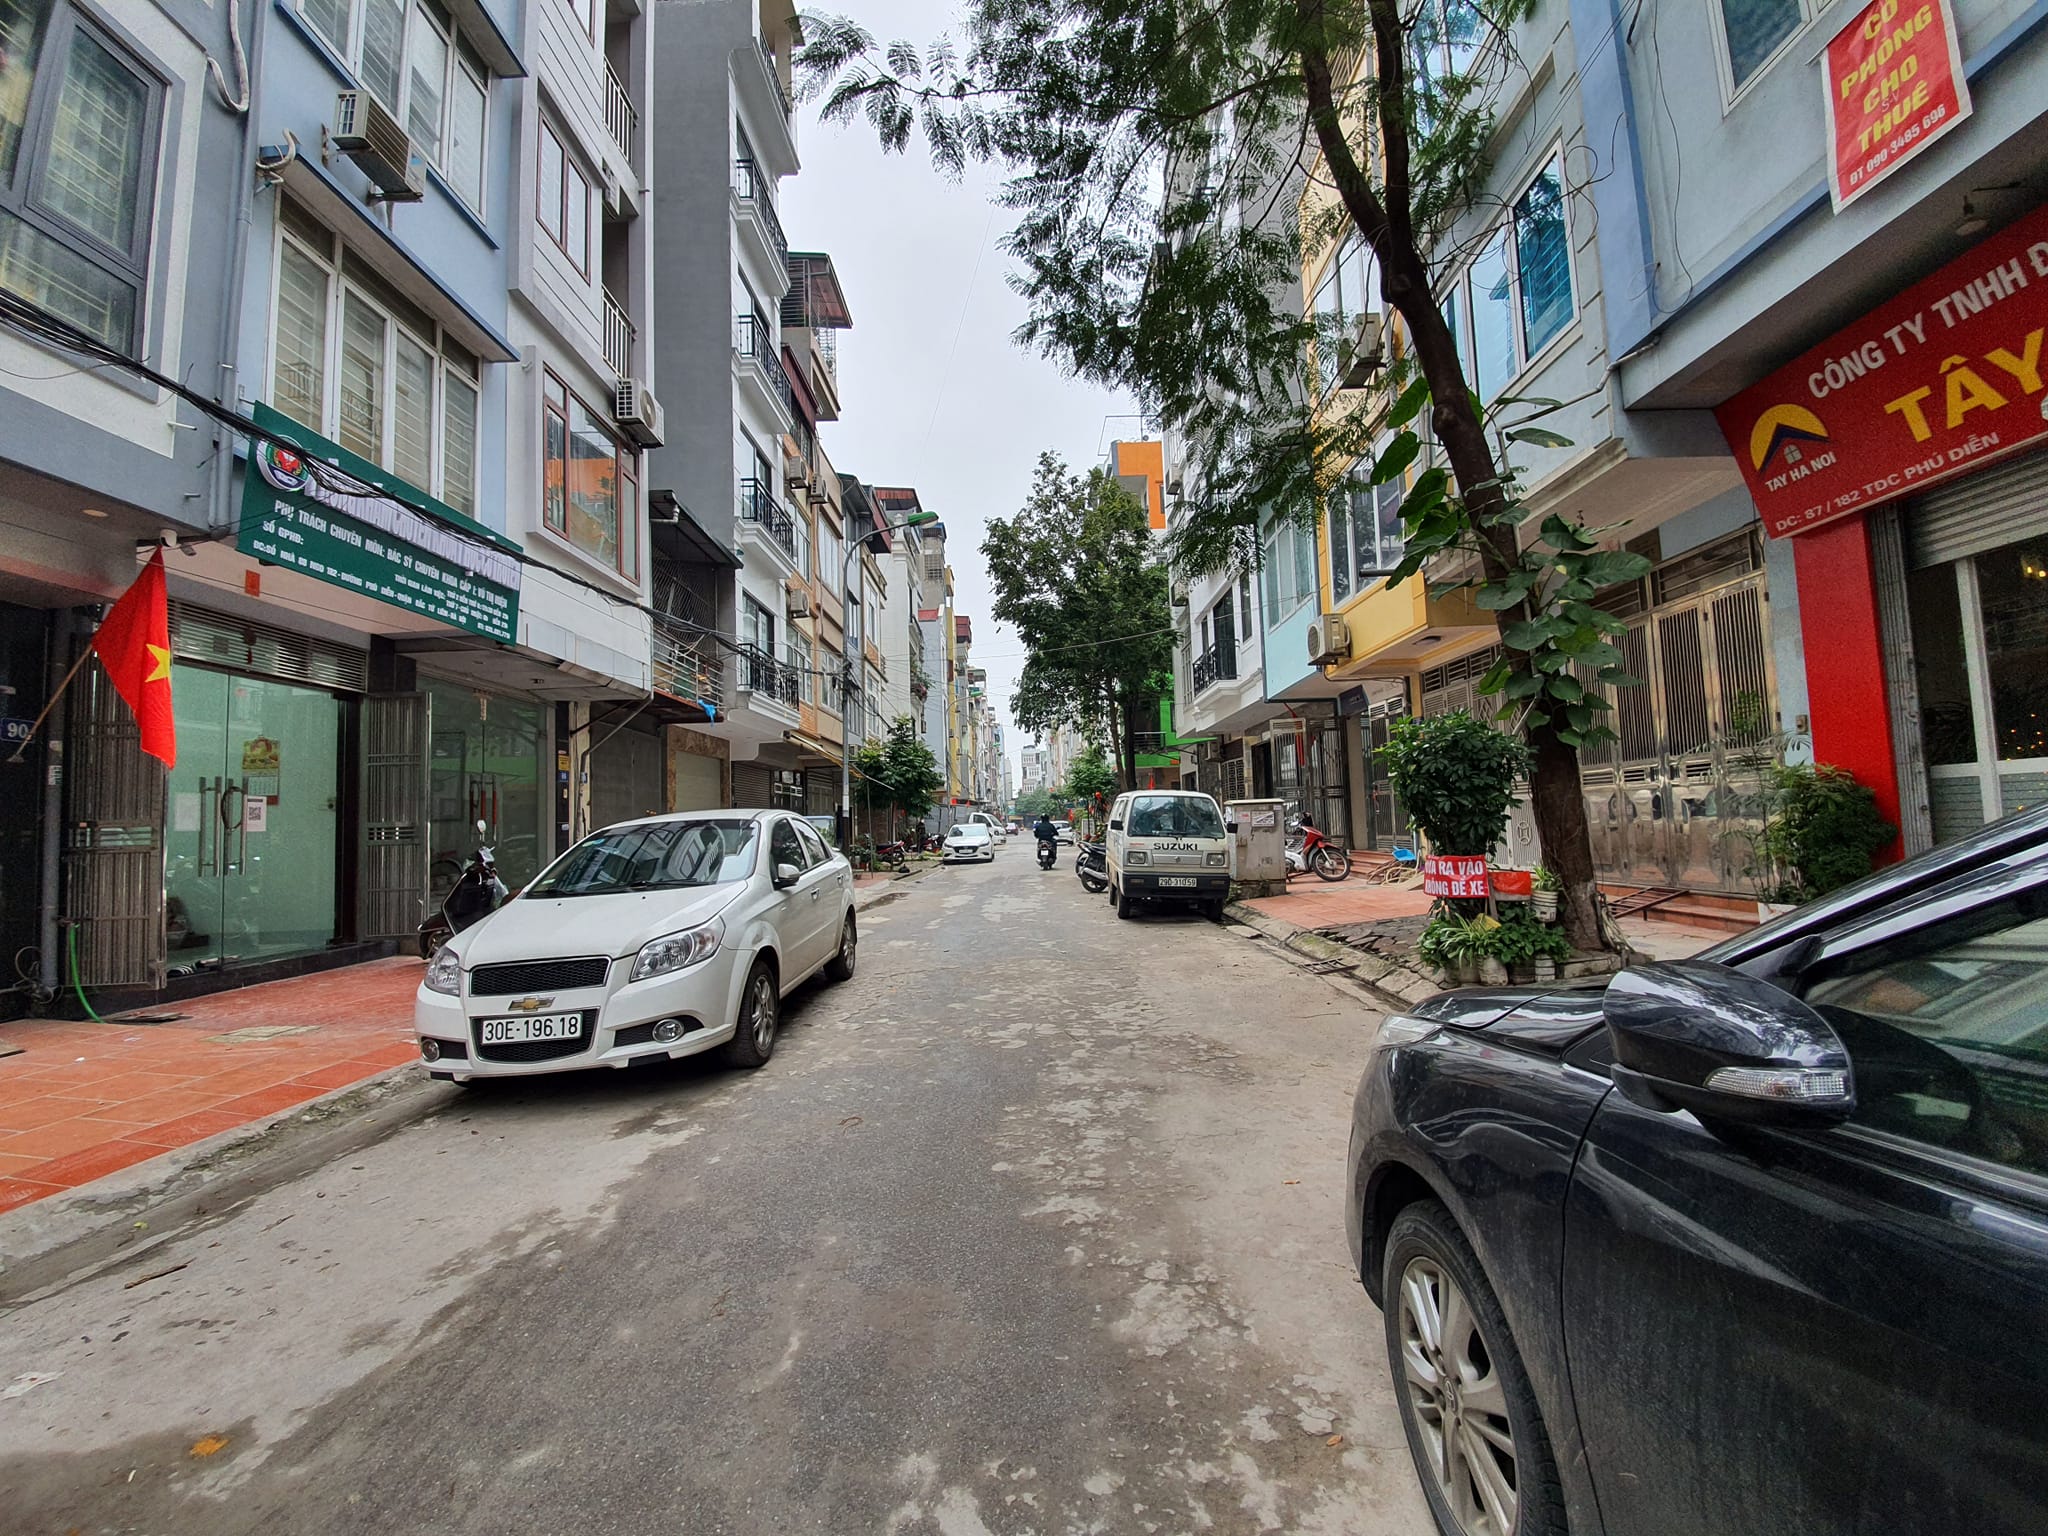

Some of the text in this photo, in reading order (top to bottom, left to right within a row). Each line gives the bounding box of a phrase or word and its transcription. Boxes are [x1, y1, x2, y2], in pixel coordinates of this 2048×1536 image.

[1841, 5, 1932, 99] PHÒNG
[1863, 54, 1918, 114] CHO
[1857, 80, 1930, 153] THUÊ
[1866, 148, 1888, 173] 090
[1890, 124, 1920, 154] 3485
[1922, 104, 1946, 130] 696
[1808, 340, 1886, 398] CÔNG
[1883, 312, 1927, 356] TY
[1930, 257, 2029, 329] TNHH
[1883, 327, 2045, 443] TÂY
[1765, 451, 1837, 493] TAY HA NOI
[1804, 505, 1823, 519] 87
[1833, 489, 1861, 508] 182
[262, 520, 276, 534] SỐ
[299, 512, 327, 533] TRÁCH
[330, 524, 362, 548] CHUYÊN
[386, 548, 401, 564] BÁC
[414, 560, 440, 580] CHUYÊN
[7, 722, 28, 739] 90
[1153, 842, 1198, 851] SUZUKI
[1438, 860, 1455, 876] RA
[1458, 859, 1484, 876] VÀO
[1469, 881, 1485, 895] XE
[484, 1016, 579, 1041] 30E-196.18
